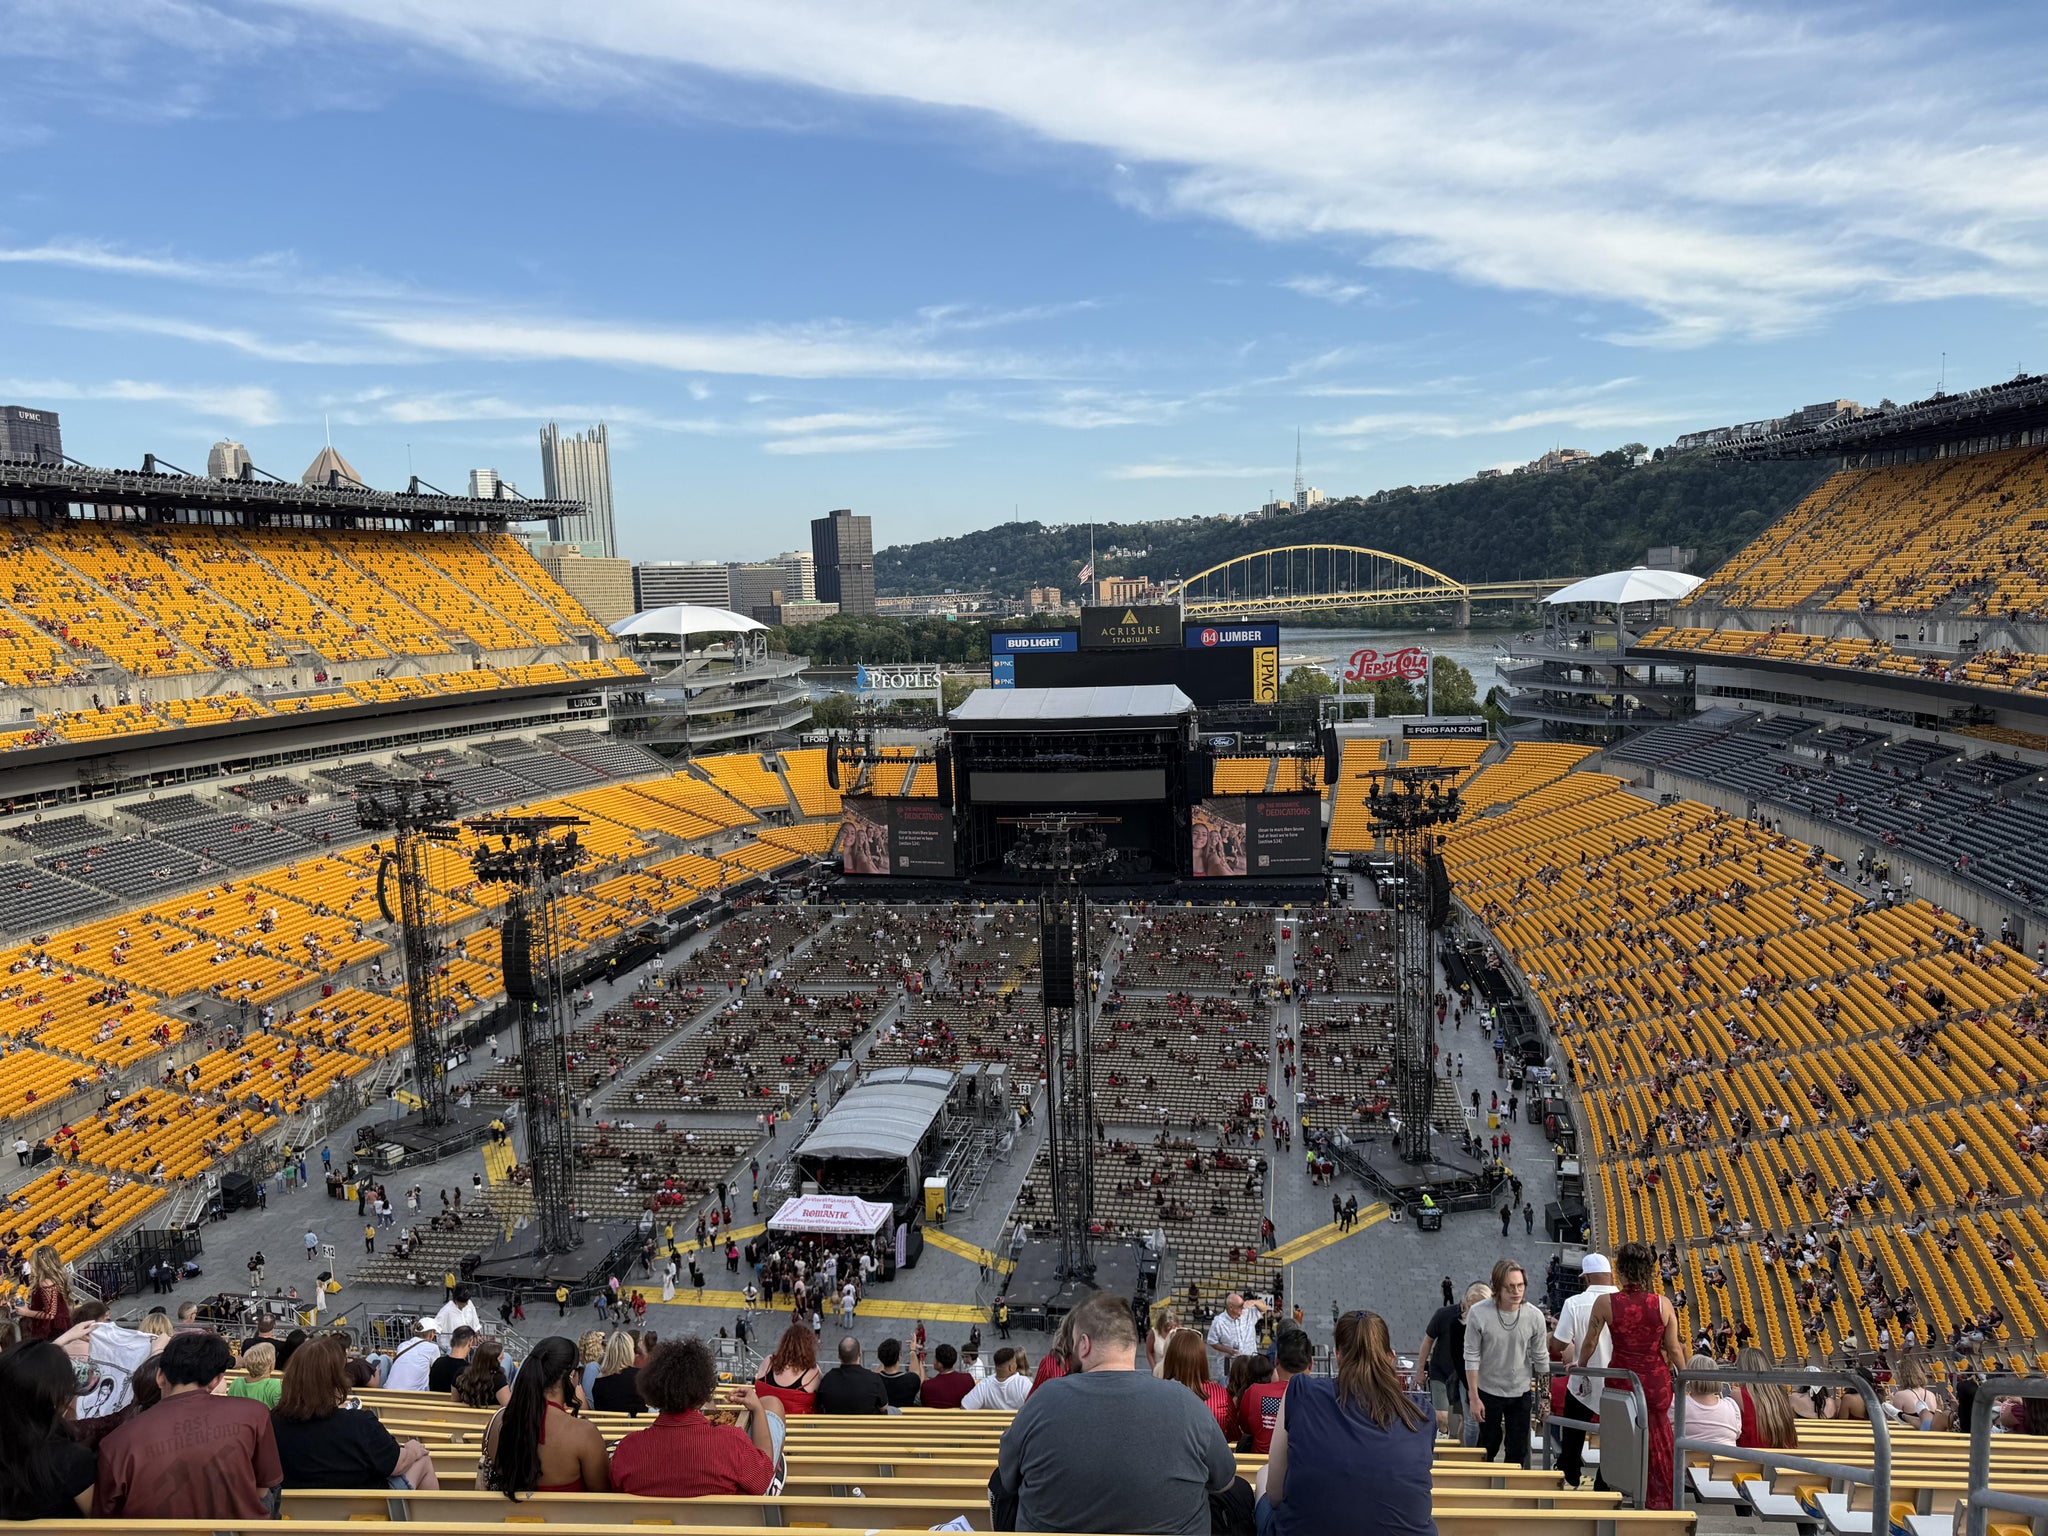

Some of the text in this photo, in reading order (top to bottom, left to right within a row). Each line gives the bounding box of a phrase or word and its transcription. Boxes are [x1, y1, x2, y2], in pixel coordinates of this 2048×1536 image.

[18, 411, 41, 421] UPMC
[1101, 626, 1161, 636] ACRISURE
[1112, 636, 1148, 644] STADIUM
[1202, 630, 1262, 643] 84 LUMBER
[1007, 638, 1060, 648] BUD LIGHT
[871, 673, 942, 688] PEOPLES
[1261, 651, 1275, 700] UPMC
[574, 698, 598, 708] UPMC
[810, 735, 829, 743] FORD
[1265, 808, 1311, 817] DEDICATIONS
[1463, 1108, 1476, 1118] F-10
[802, 1209, 849, 1219] ROMANTIC
[323, 1246, 335, 1257] F-12
[173, 1414, 208, 1436] EAST
[144, 1422, 240, 1457] RUTHERFORD
